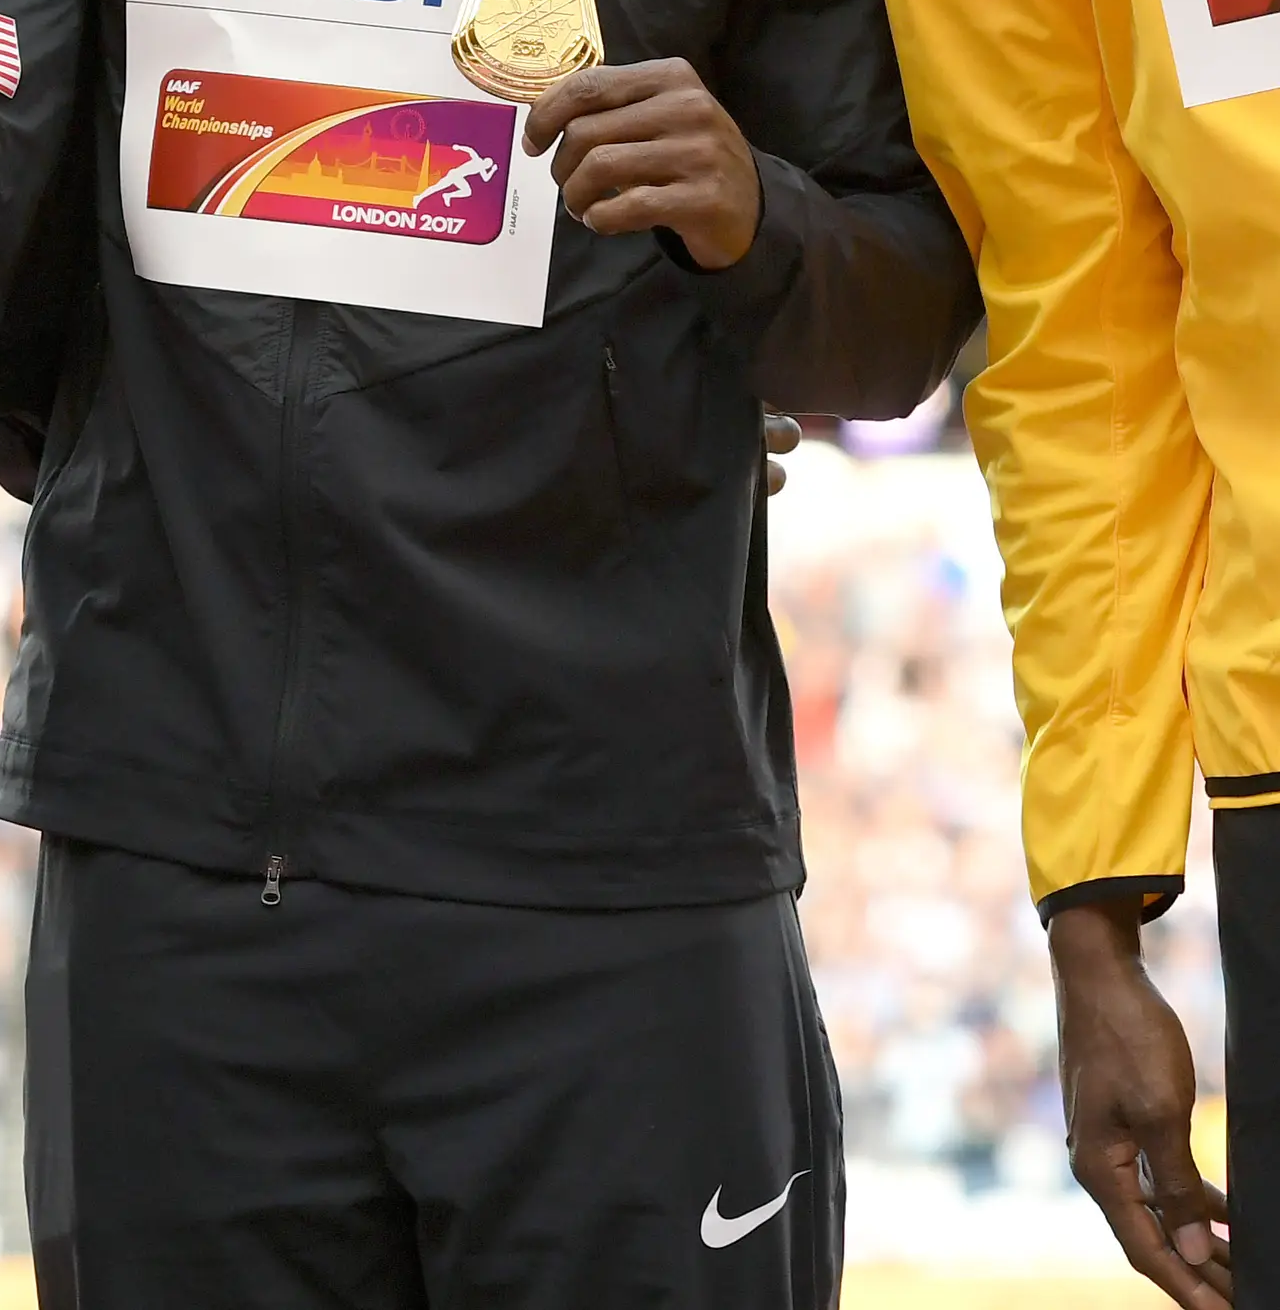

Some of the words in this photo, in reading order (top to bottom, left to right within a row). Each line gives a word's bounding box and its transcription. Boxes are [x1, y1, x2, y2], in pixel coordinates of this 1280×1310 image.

[166, 80, 201, 94] IAAF
[164, 96, 205, 114] World
[161, 113, 274, 139] Championships
[331, 204, 417, 231] LONDON
[419, 214, 466, 235] 2017
